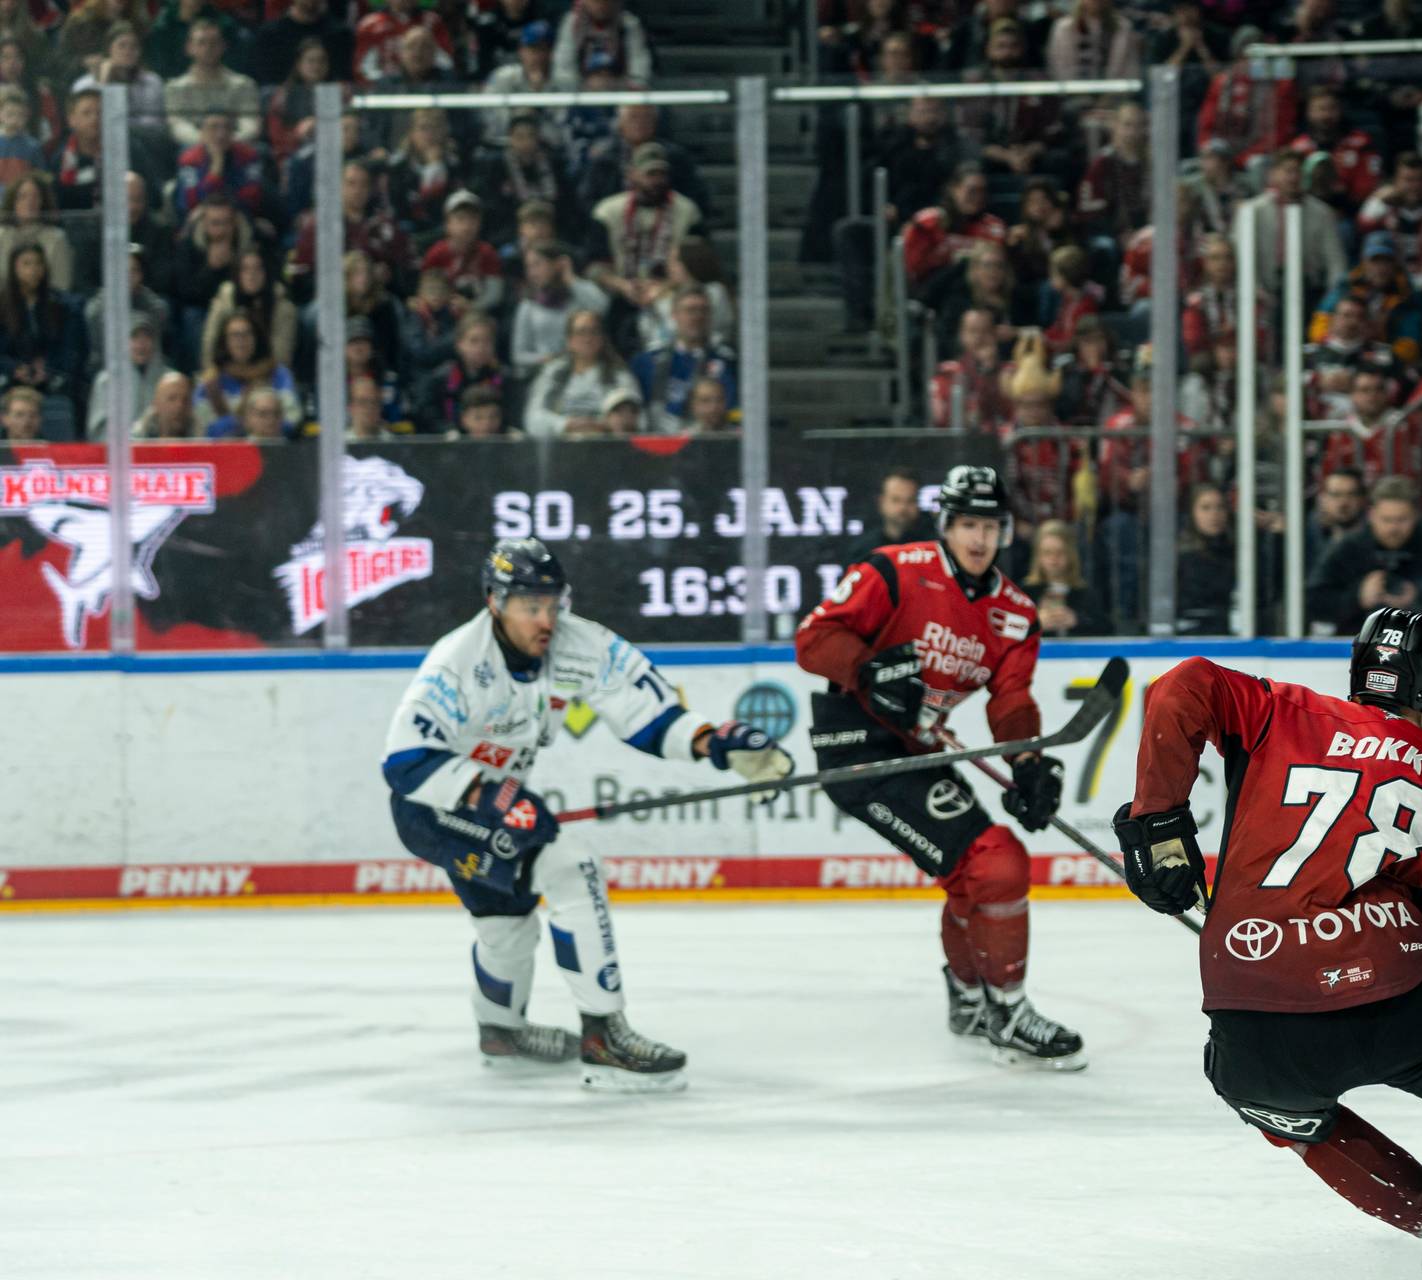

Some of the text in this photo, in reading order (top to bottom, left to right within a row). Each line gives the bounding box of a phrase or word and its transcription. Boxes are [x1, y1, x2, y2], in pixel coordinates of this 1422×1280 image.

[493, 490, 591, 541] SO.
[608, 489, 700, 539] 25.
[713, 486, 863, 537] JAN.
[639, 565, 802, 617] 16:30
[922, 621, 986, 662] Rhein
[1381, 628, 1403, 646] 78
[891, 815, 944, 865] TOYOTA
[1287, 900, 1420, 946] TOYOTA
